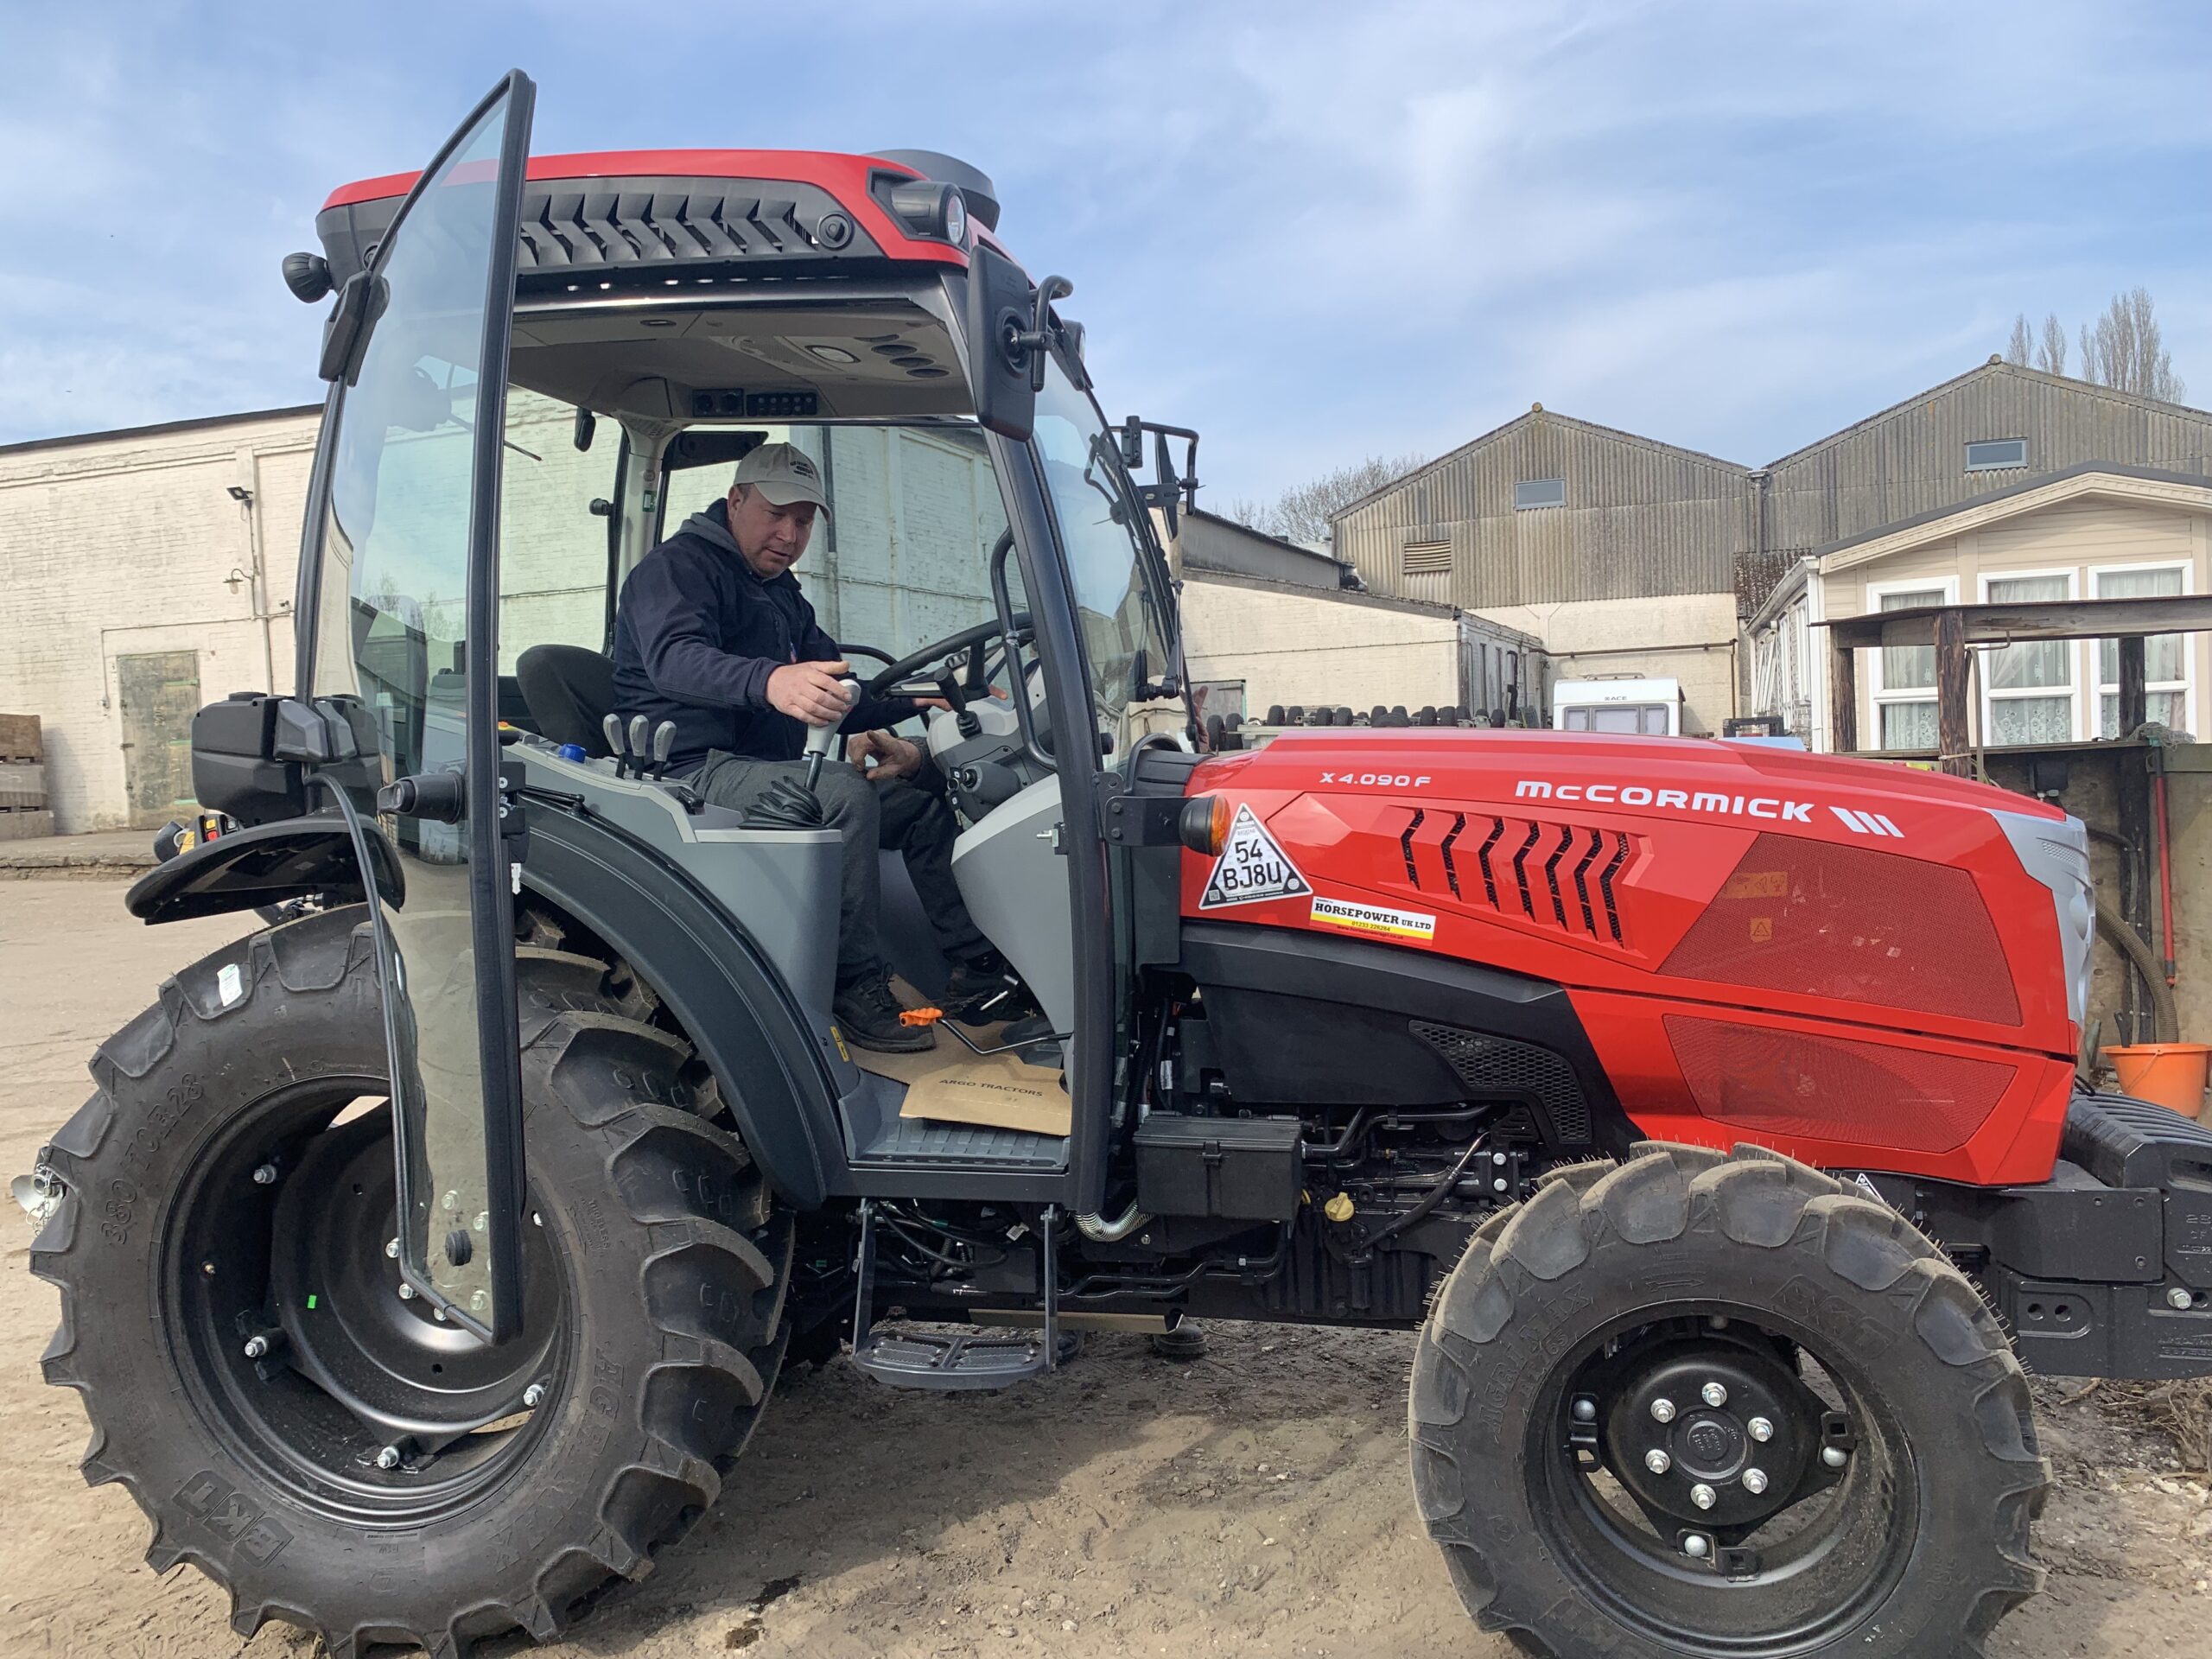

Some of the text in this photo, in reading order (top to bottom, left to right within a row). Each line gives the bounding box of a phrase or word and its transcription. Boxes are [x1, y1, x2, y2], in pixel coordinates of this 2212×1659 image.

[1516, 780, 1815, 823] McCORMICK
[1235, 838, 1263, 863] 54
[1223, 861, 1282, 890] BJ8U
[1314, 902, 1399, 925] HORSEPOWER
[1401, 918, 1413, 927] UK
[981, 1083, 1043, 1096] TRACTORS
[177, 1476, 289, 1564] BKT
